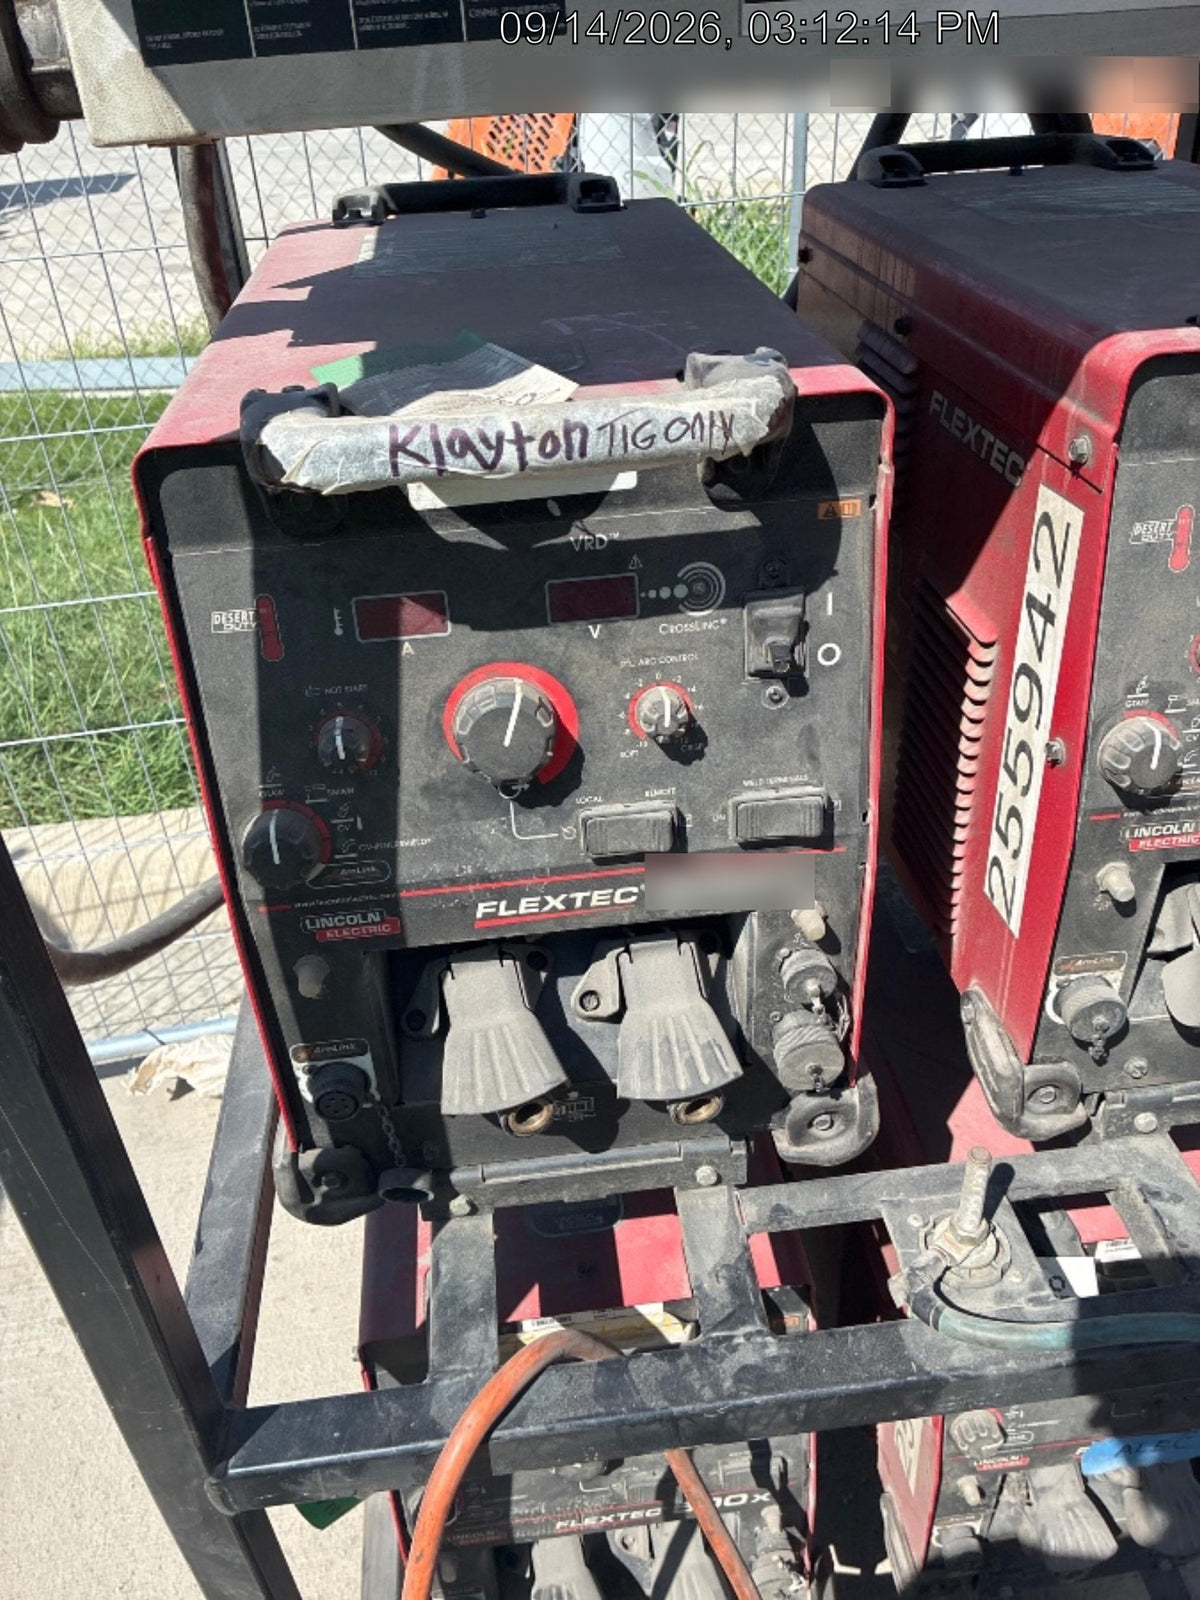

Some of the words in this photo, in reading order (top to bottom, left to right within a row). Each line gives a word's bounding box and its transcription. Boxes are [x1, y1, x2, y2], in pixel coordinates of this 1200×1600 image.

[389, 419, 589, 477] Klayton
[598, 408, 656, 457] TIG
[930, 390, 1025, 487] FLEXTEC
[213, 611, 255, 625] DESERT
[587, 624, 602, 640] V
[401, 641, 415, 657] A
[988, 511, 1071, 925] 255942
[1125, 822, 1196, 838] LINCOLN
[1139, 832, 1200, 848] ELECTRIC
[475, 885, 640, 919] FLEXTEC
[305, 911, 382, 929] LINCOLN
[326, 924, 392, 939] ELECTRIC
[555, 1507, 663, 1530] FLEXTEC
